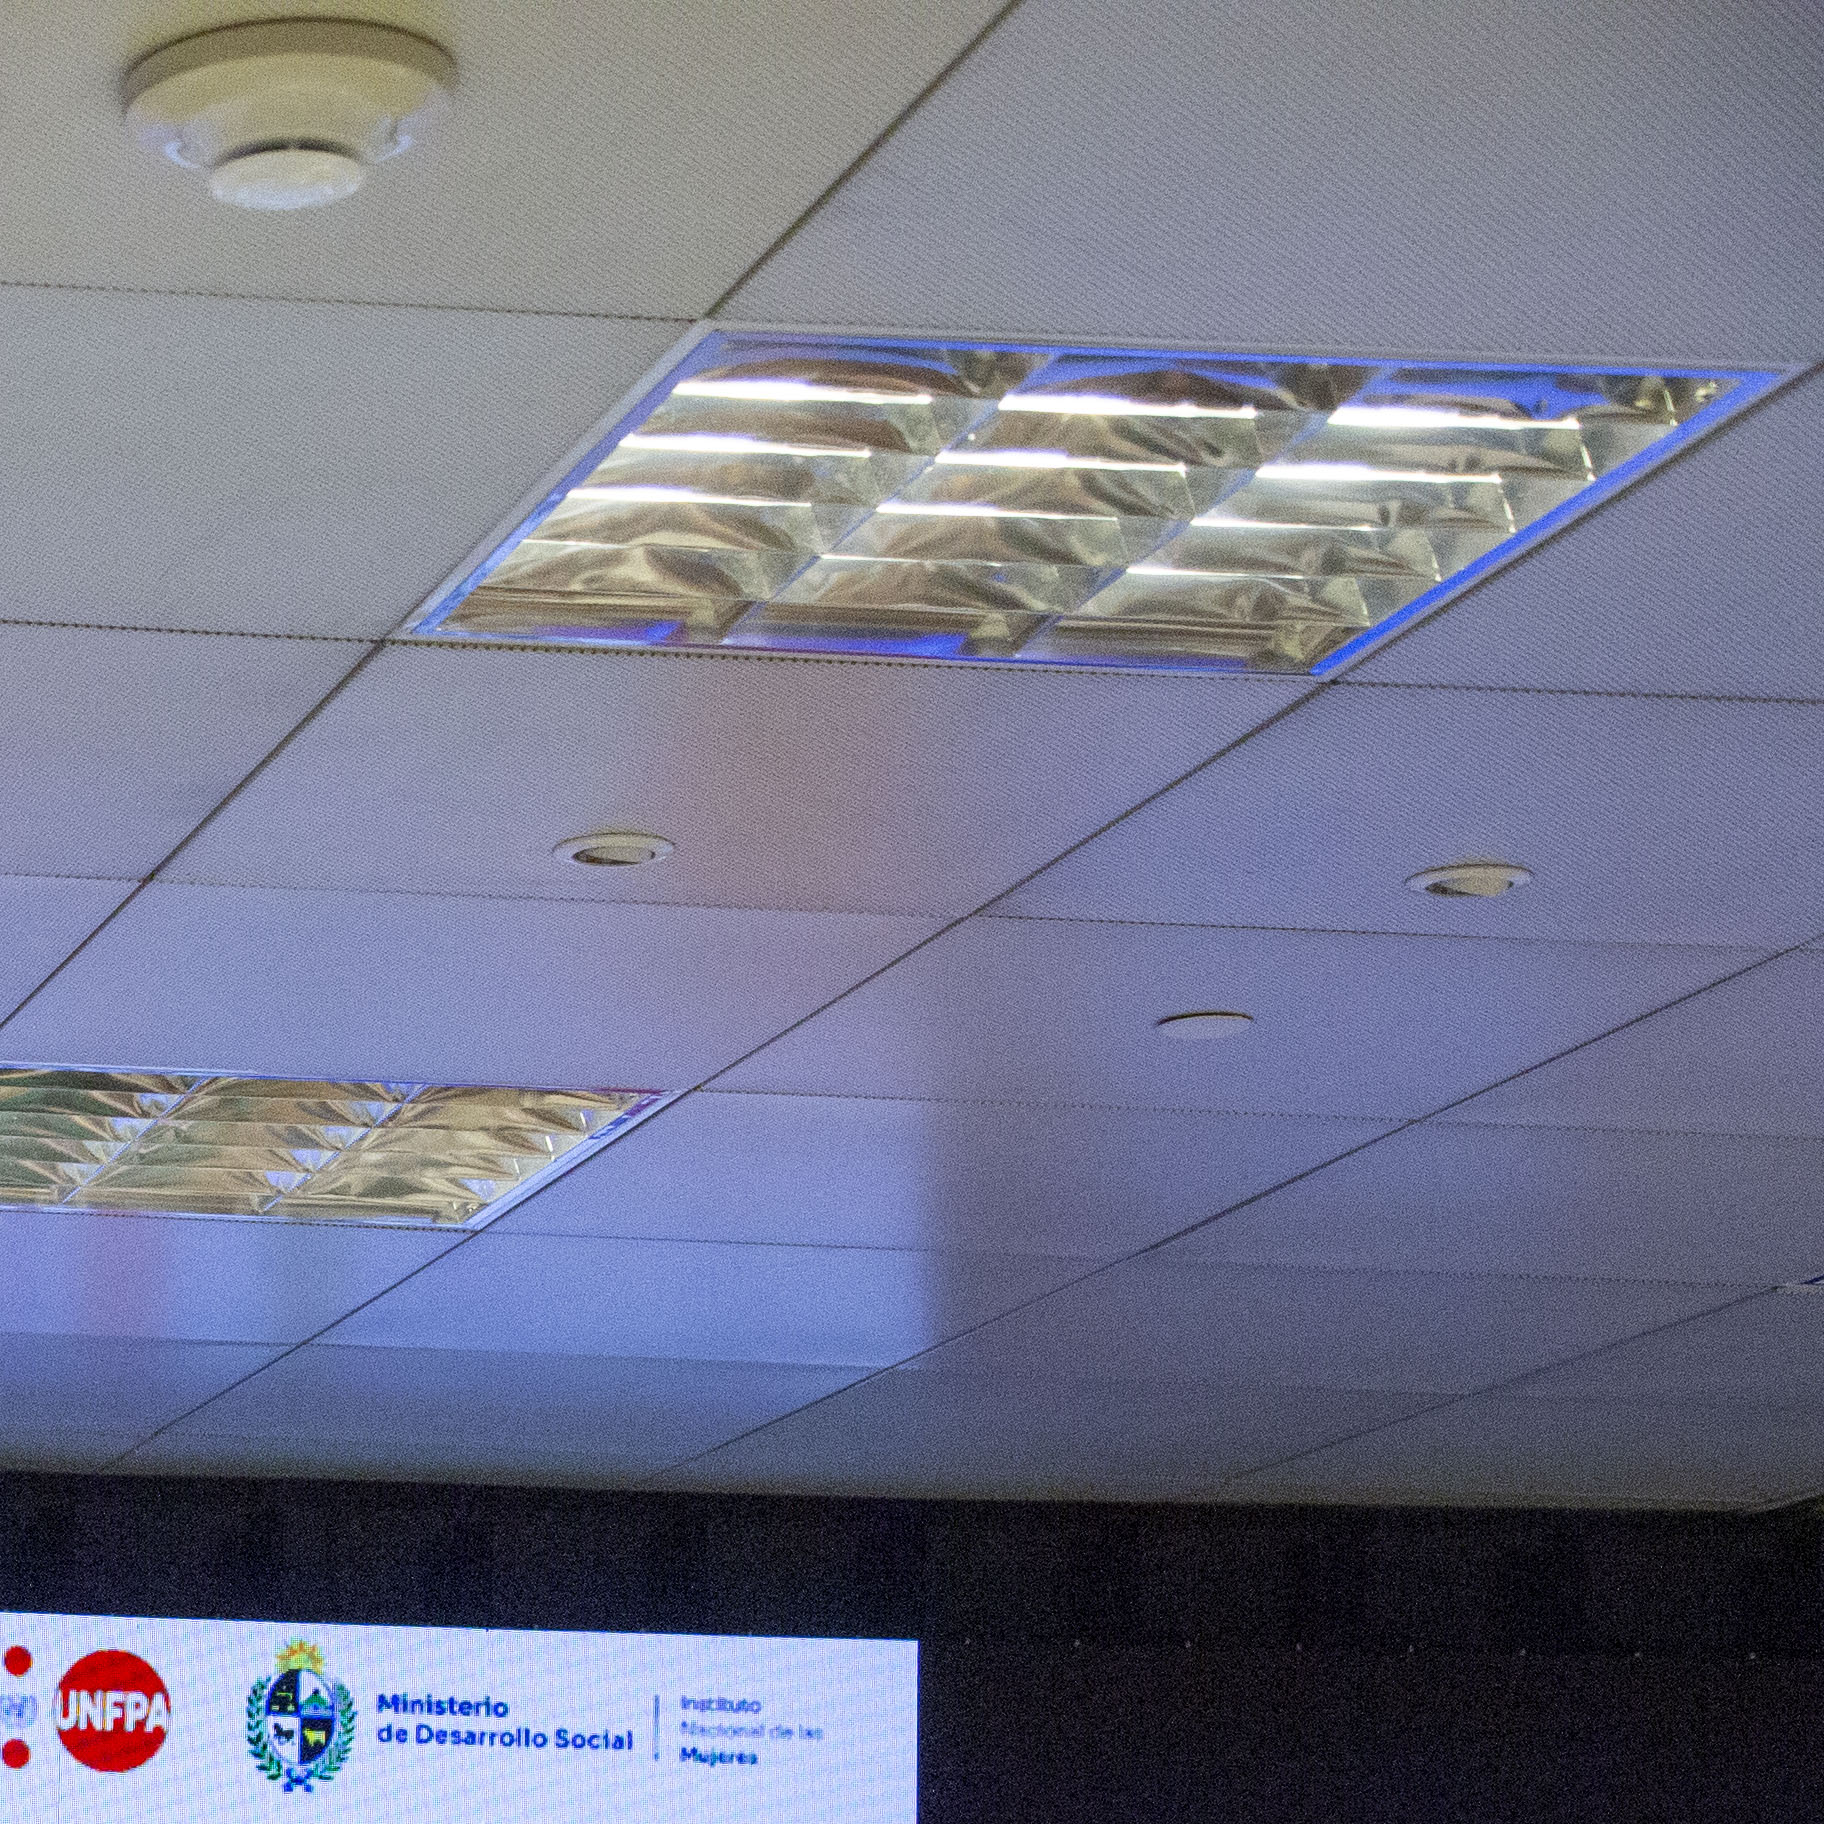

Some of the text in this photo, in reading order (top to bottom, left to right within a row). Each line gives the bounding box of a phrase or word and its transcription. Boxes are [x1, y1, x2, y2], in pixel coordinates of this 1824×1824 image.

[54, 1690, 172, 1733] UNFPA
[377, 1694, 509, 1718] Ministerio
[377, 1724, 633, 1751] de Desarrollo Social
[679, 1746, 758, 1767] Mujeres
